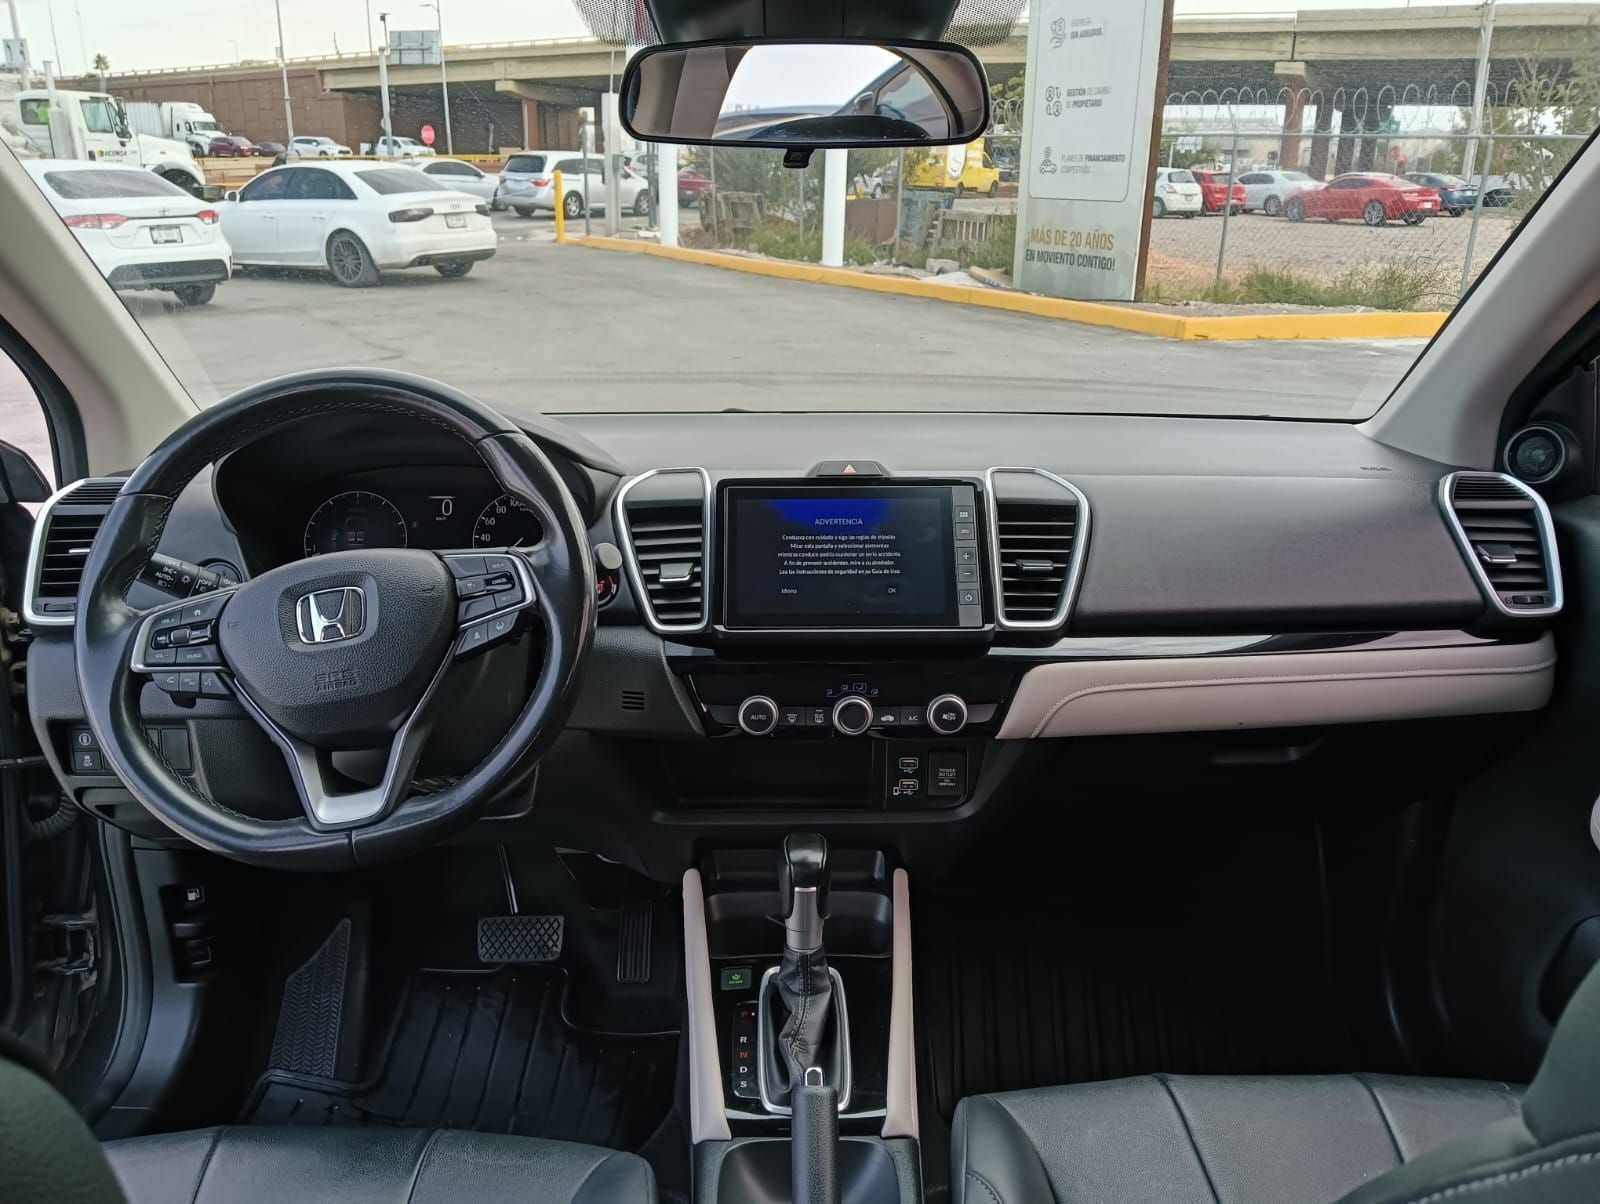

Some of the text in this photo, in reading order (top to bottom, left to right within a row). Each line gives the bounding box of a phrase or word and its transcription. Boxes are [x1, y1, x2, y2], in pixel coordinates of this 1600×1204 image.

[1054, 229, 1068, 247] DE
[1070, 231, 1082, 248] 20
[1084, 229, 1114, 251] AÑOS
[1025, 248, 1115, 271] EN MOVIENTO CONTIGO!
[441, 499, 453, 516] 0
[496, 505, 507, 514] 80
[484, 517, 496, 526] 60
[814, 518, 864, 526] ADVERTENCIA
[480, 533, 491, 542] 40
[740, 1080, 748, 1088] S
